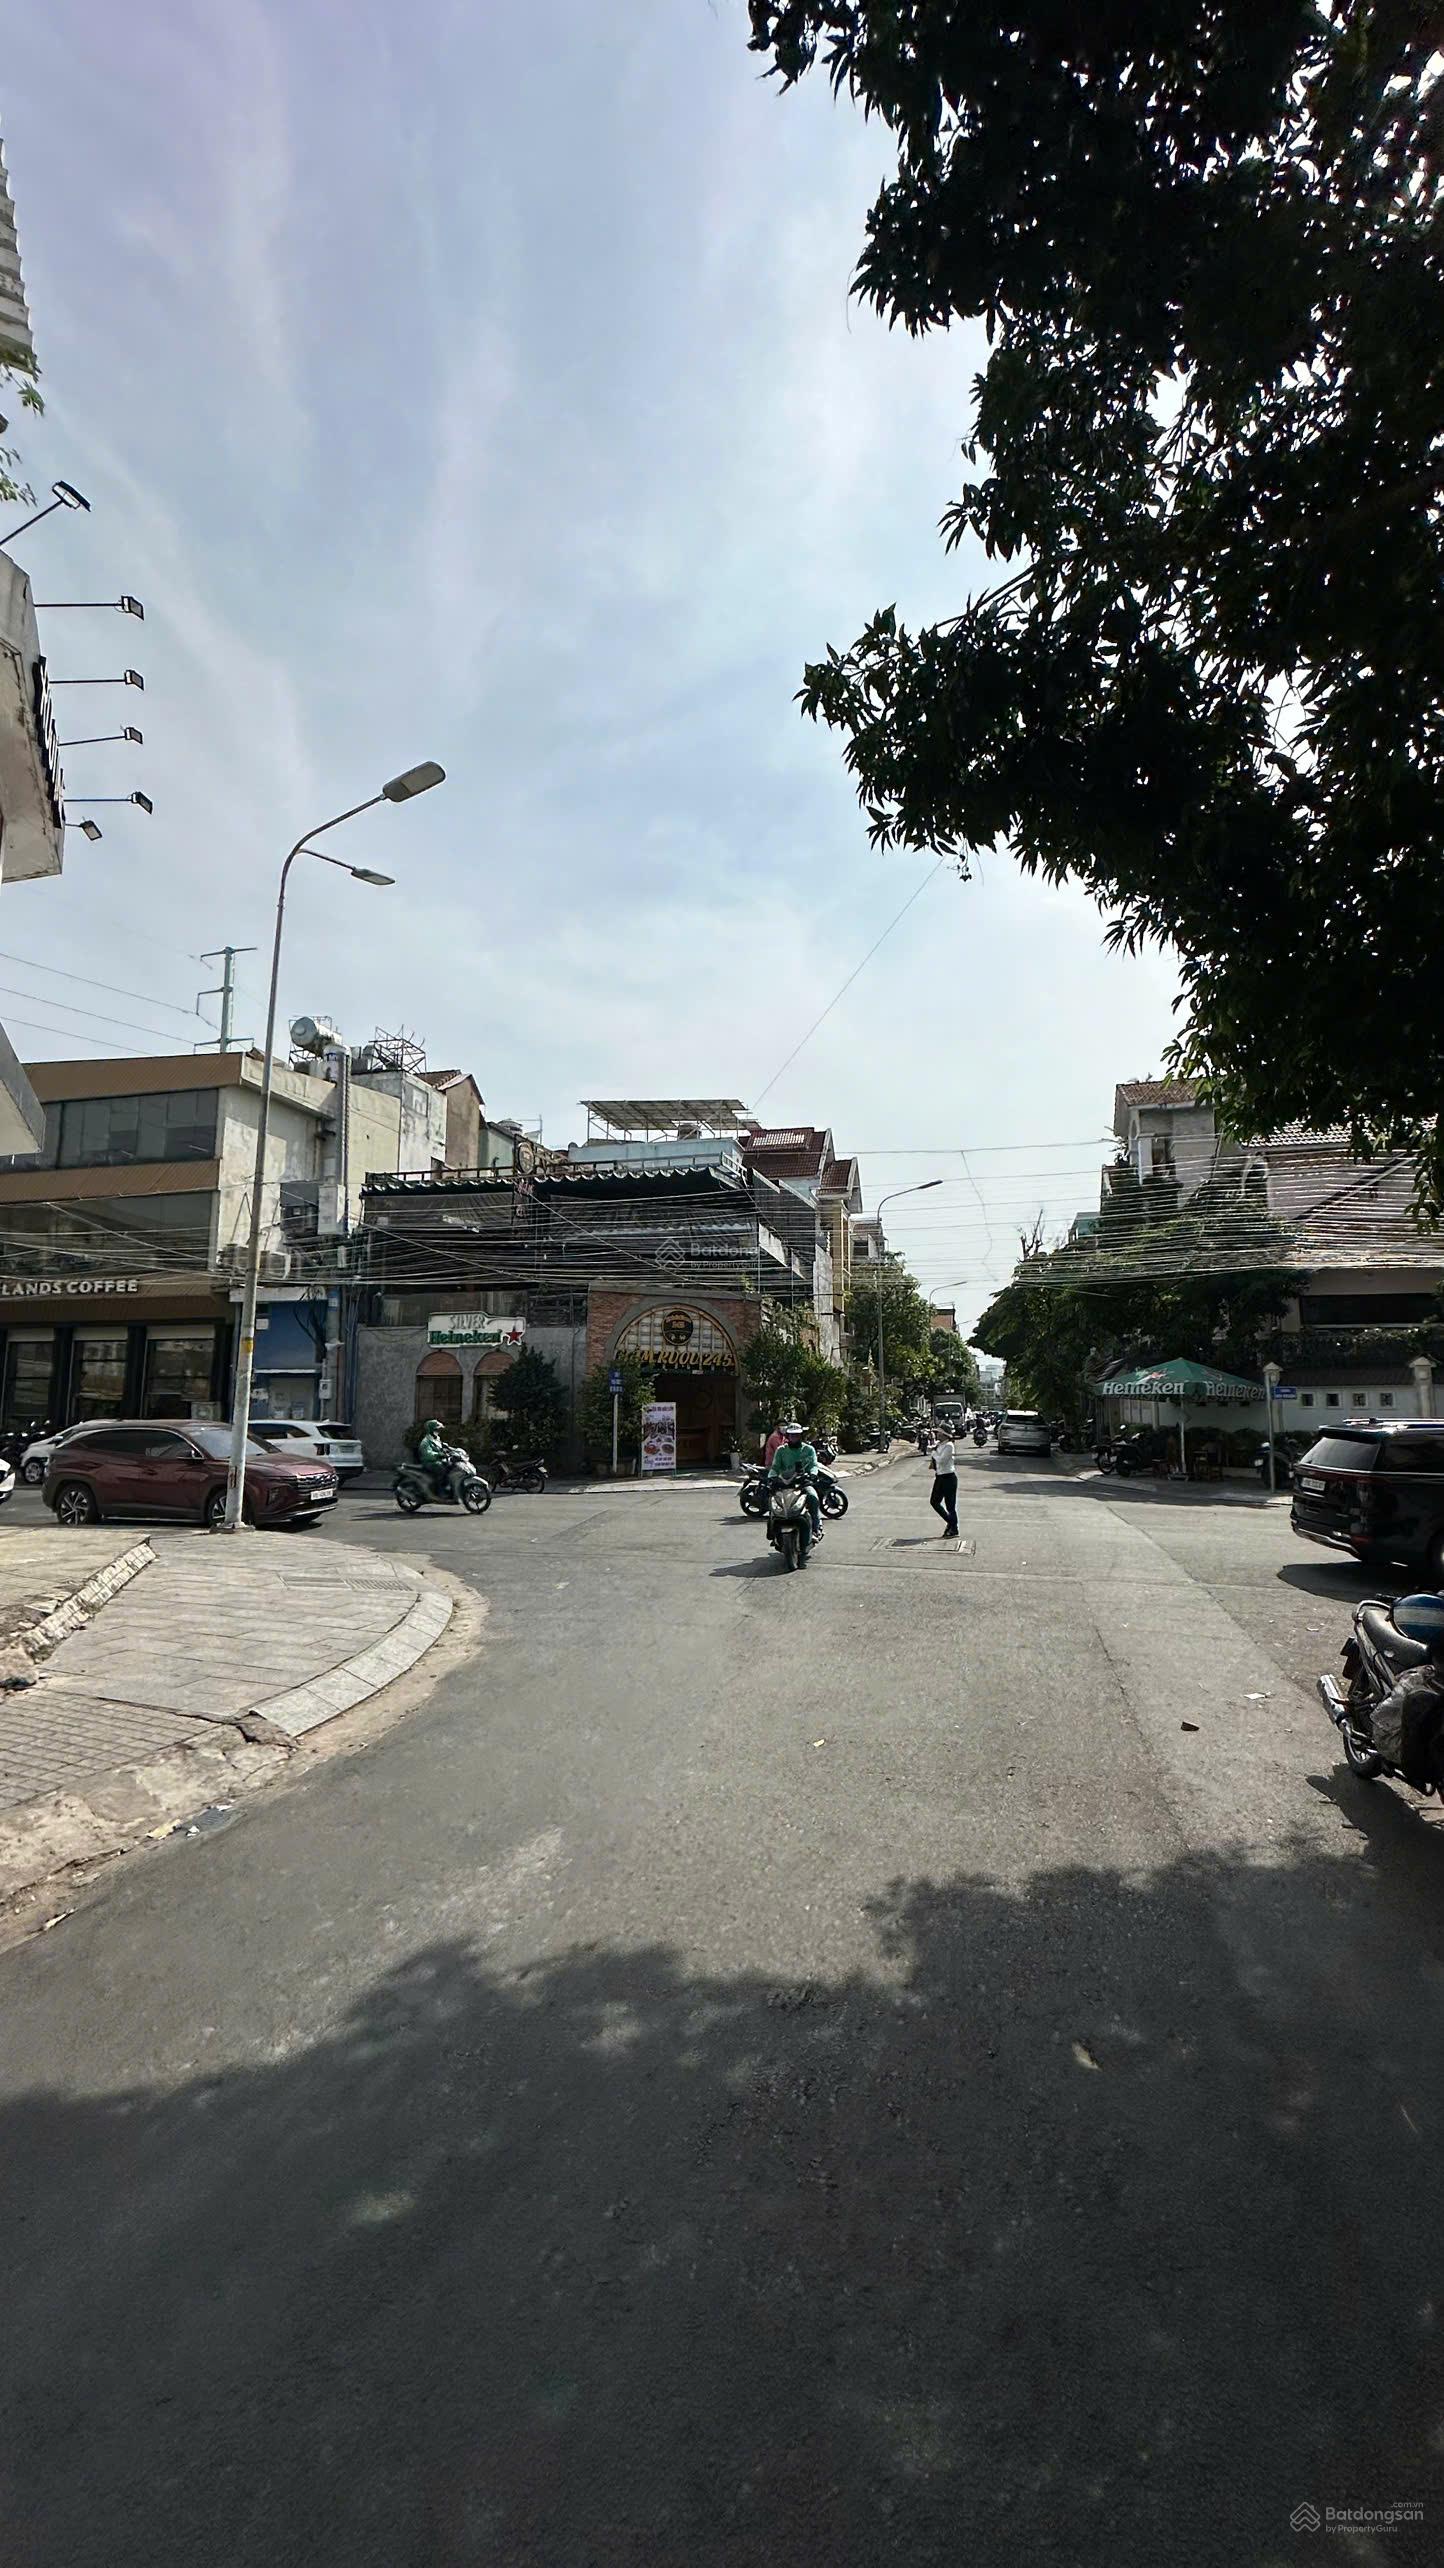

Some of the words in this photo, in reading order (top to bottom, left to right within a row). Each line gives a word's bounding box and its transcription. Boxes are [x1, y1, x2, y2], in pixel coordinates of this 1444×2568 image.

[1, 1282, 62, 1296] LANDS
[66, 1279, 138, 1294] COFFEE
[449, 1314, 485, 1330] SILVER
[429, 1330, 502, 1344] Heineken
[702, 1352, 733, 1366] 245
